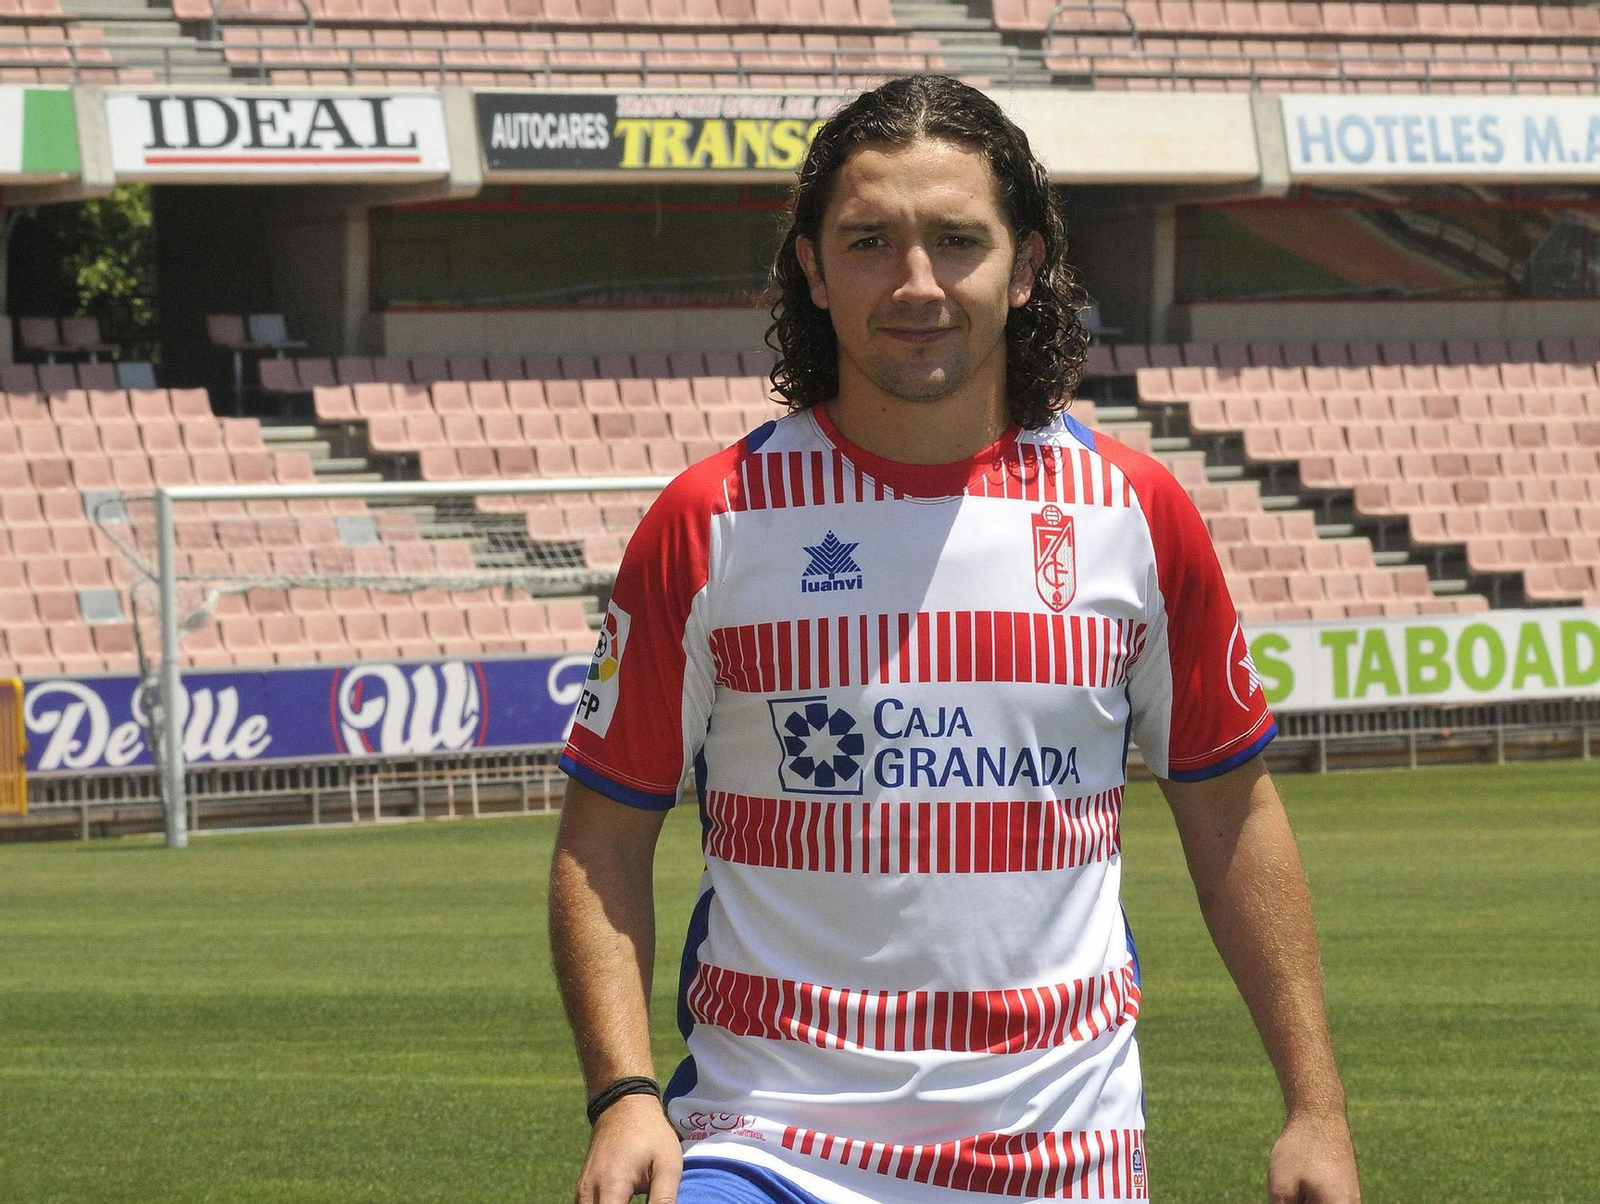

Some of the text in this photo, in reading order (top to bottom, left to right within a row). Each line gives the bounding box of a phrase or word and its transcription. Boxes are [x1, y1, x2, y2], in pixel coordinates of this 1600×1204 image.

[138, 95, 417, 150] IDEAL
[491, 113, 609, 149] AUTOCARES
[1301, 113, 1504, 164] HOTELES
[801, 574, 863, 593] luanvi
[1320, 619, 1600, 699] TABOAD
[873, 698, 973, 738] CAJA
[873, 745, 1081, 788] GRANADA
